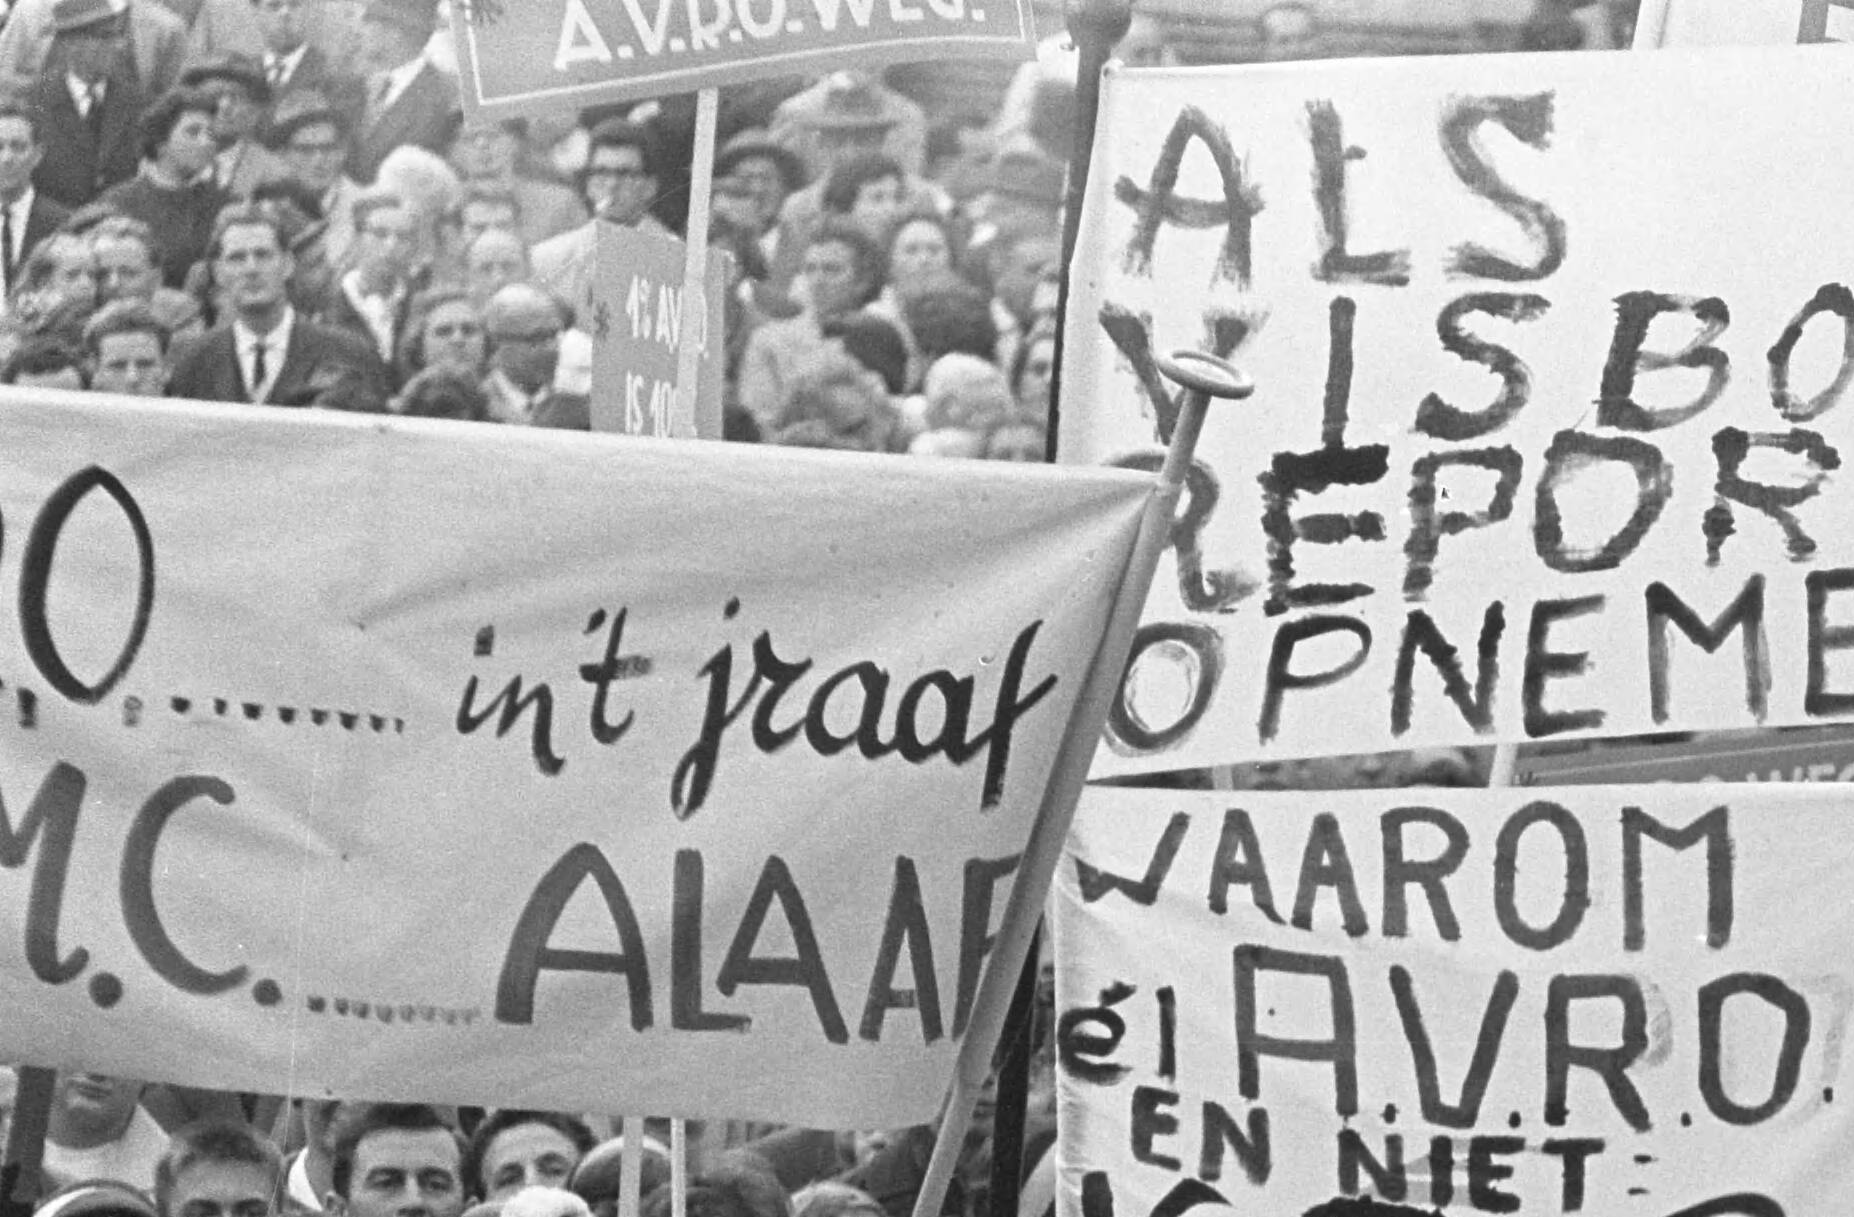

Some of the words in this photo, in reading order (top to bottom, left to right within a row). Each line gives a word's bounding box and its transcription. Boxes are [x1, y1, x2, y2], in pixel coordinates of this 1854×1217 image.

[1112, 88, 1568, 290] ALS
[1074, 800, 1736, 951] WAAROM
[1130, 1082, 1272, 1187] EN
